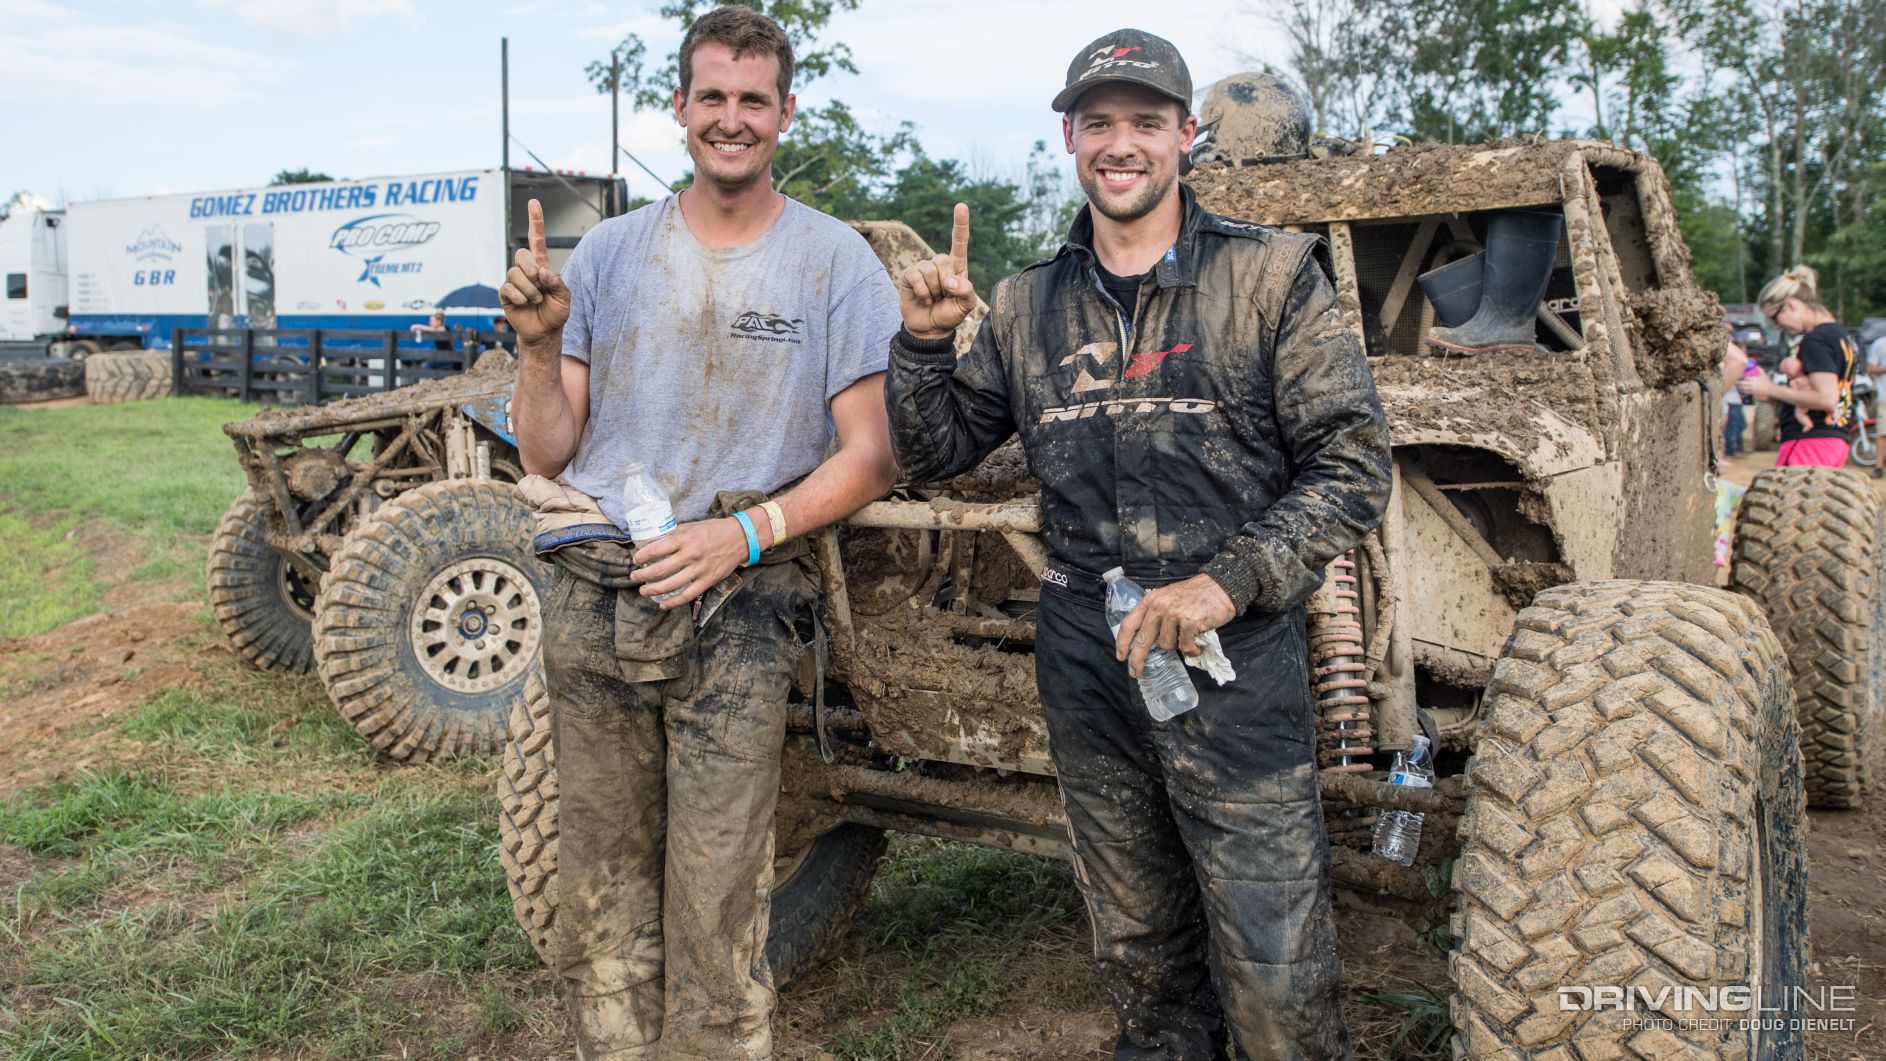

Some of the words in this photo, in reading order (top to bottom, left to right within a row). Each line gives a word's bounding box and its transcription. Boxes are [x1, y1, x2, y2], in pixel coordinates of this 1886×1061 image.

[1080, 60, 1152, 81] NITTO
[189, 194, 256, 218] GOMEZ
[262, 185, 378, 213] BROTHERS
[385, 176, 479, 206] RACING
[126, 239, 182, 254] MOUNTAIN
[330, 226, 376, 248] PRO
[374, 221, 441, 246] COMP
[1040, 397, 1216, 424] NITTO
